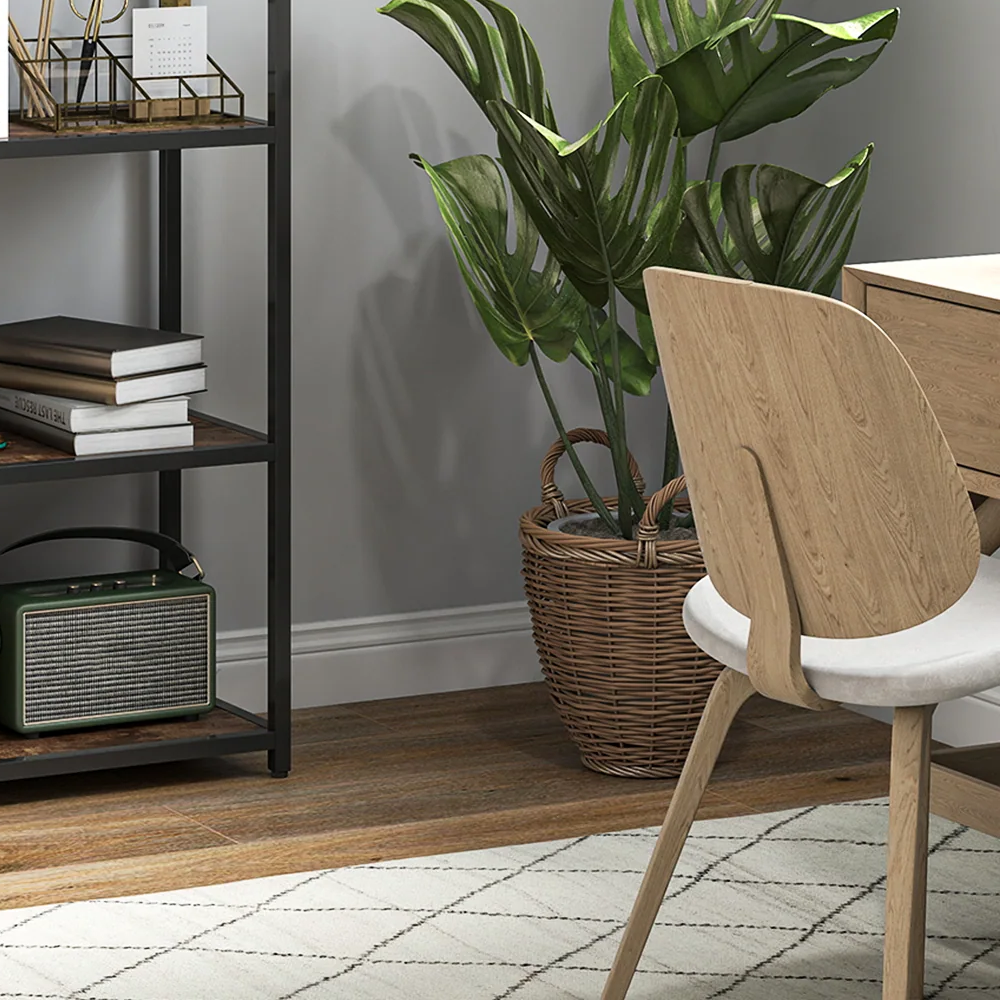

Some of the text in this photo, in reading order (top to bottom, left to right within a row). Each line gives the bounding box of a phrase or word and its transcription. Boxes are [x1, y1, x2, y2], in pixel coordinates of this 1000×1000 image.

[14, 396, 37, 415] RESCUE
[37, 404, 53, 421] LAST
[53, 409, 66, 425] THE
